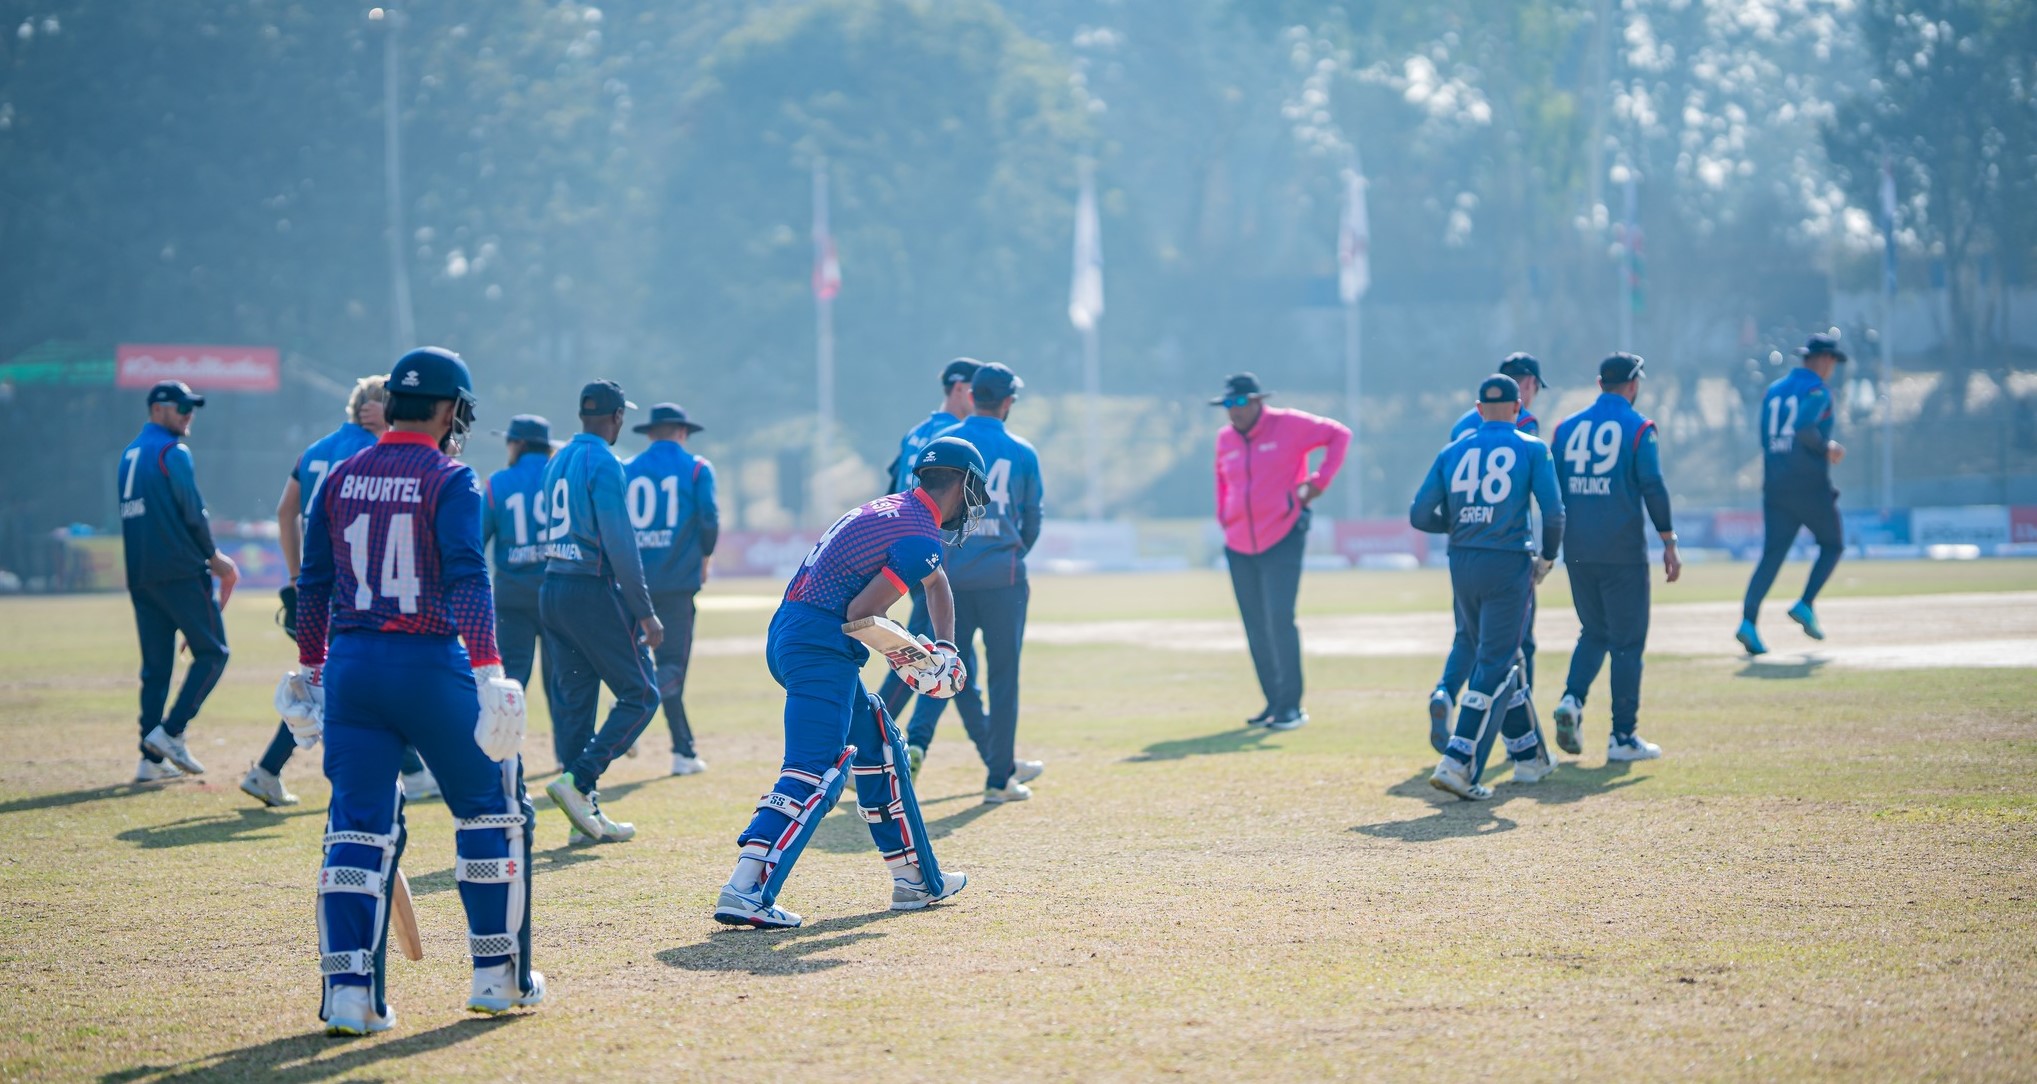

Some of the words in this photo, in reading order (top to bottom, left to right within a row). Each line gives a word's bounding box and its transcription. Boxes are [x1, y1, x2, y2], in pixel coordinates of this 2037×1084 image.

[1768, 395, 1798, 436] 12
[1451, 446, 1517, 504] 48
[1564, 420, 1622, 475] 49
[340, 474, 422, 503] BHURTEL
[548, 478, 572, 541] 9
[344, 512, 420, 613] 14
